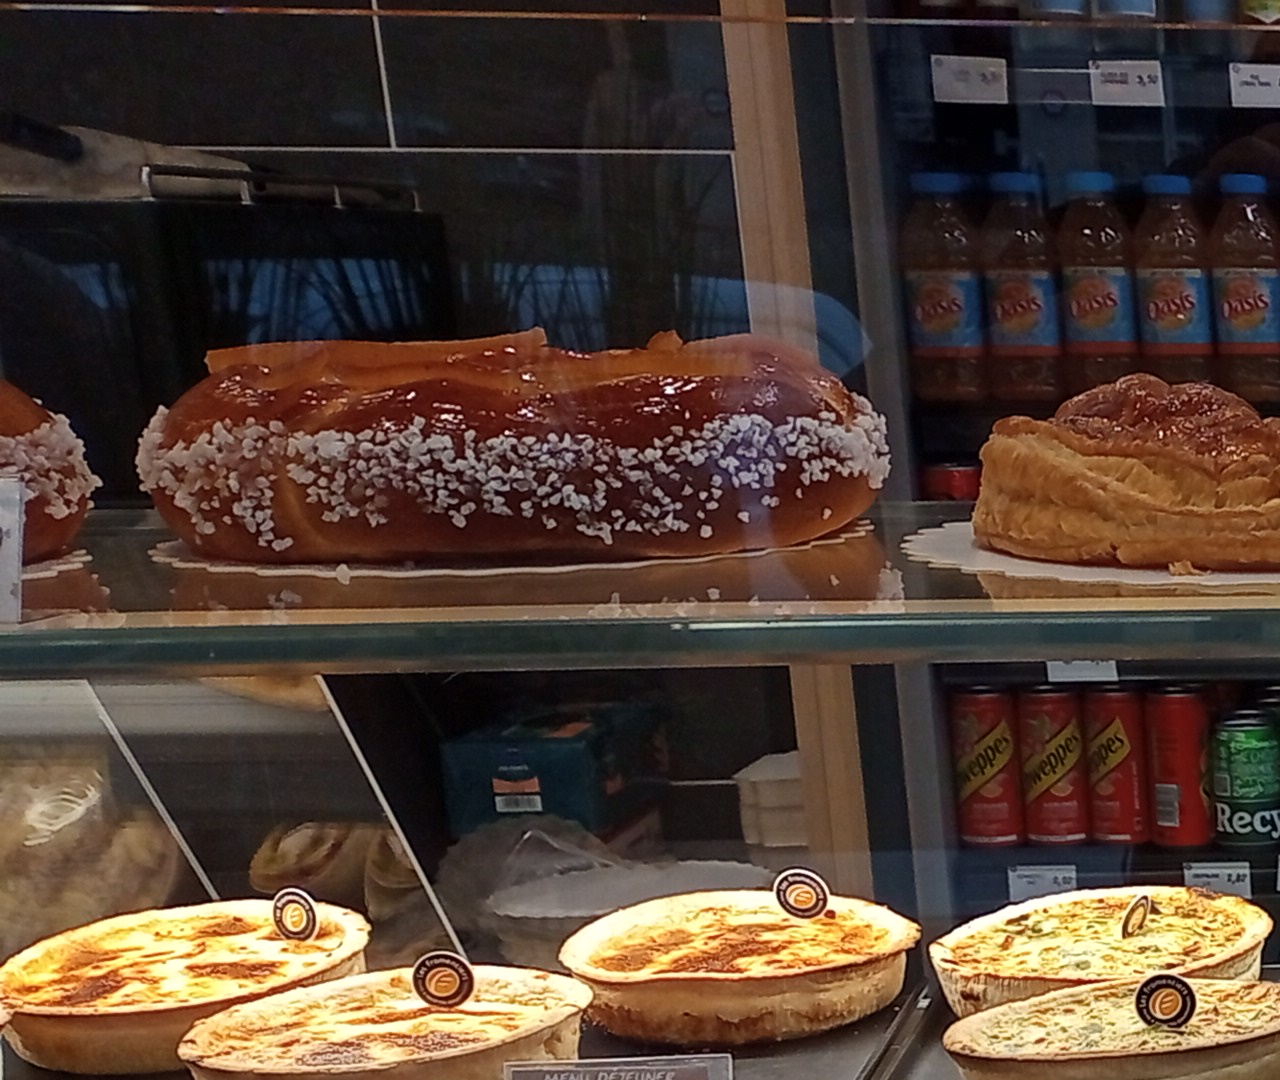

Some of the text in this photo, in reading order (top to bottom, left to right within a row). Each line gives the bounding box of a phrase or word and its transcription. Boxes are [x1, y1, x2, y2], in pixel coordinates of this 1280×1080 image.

[916, 296, 963, 323] Oasis
[995, 294, 1043, 320] Oasis
[1070, 291, 1119, 318] Oasis
[1149, 291, 1196, 322] Oasis
[1221, 290, 1269, 320] Oasis
